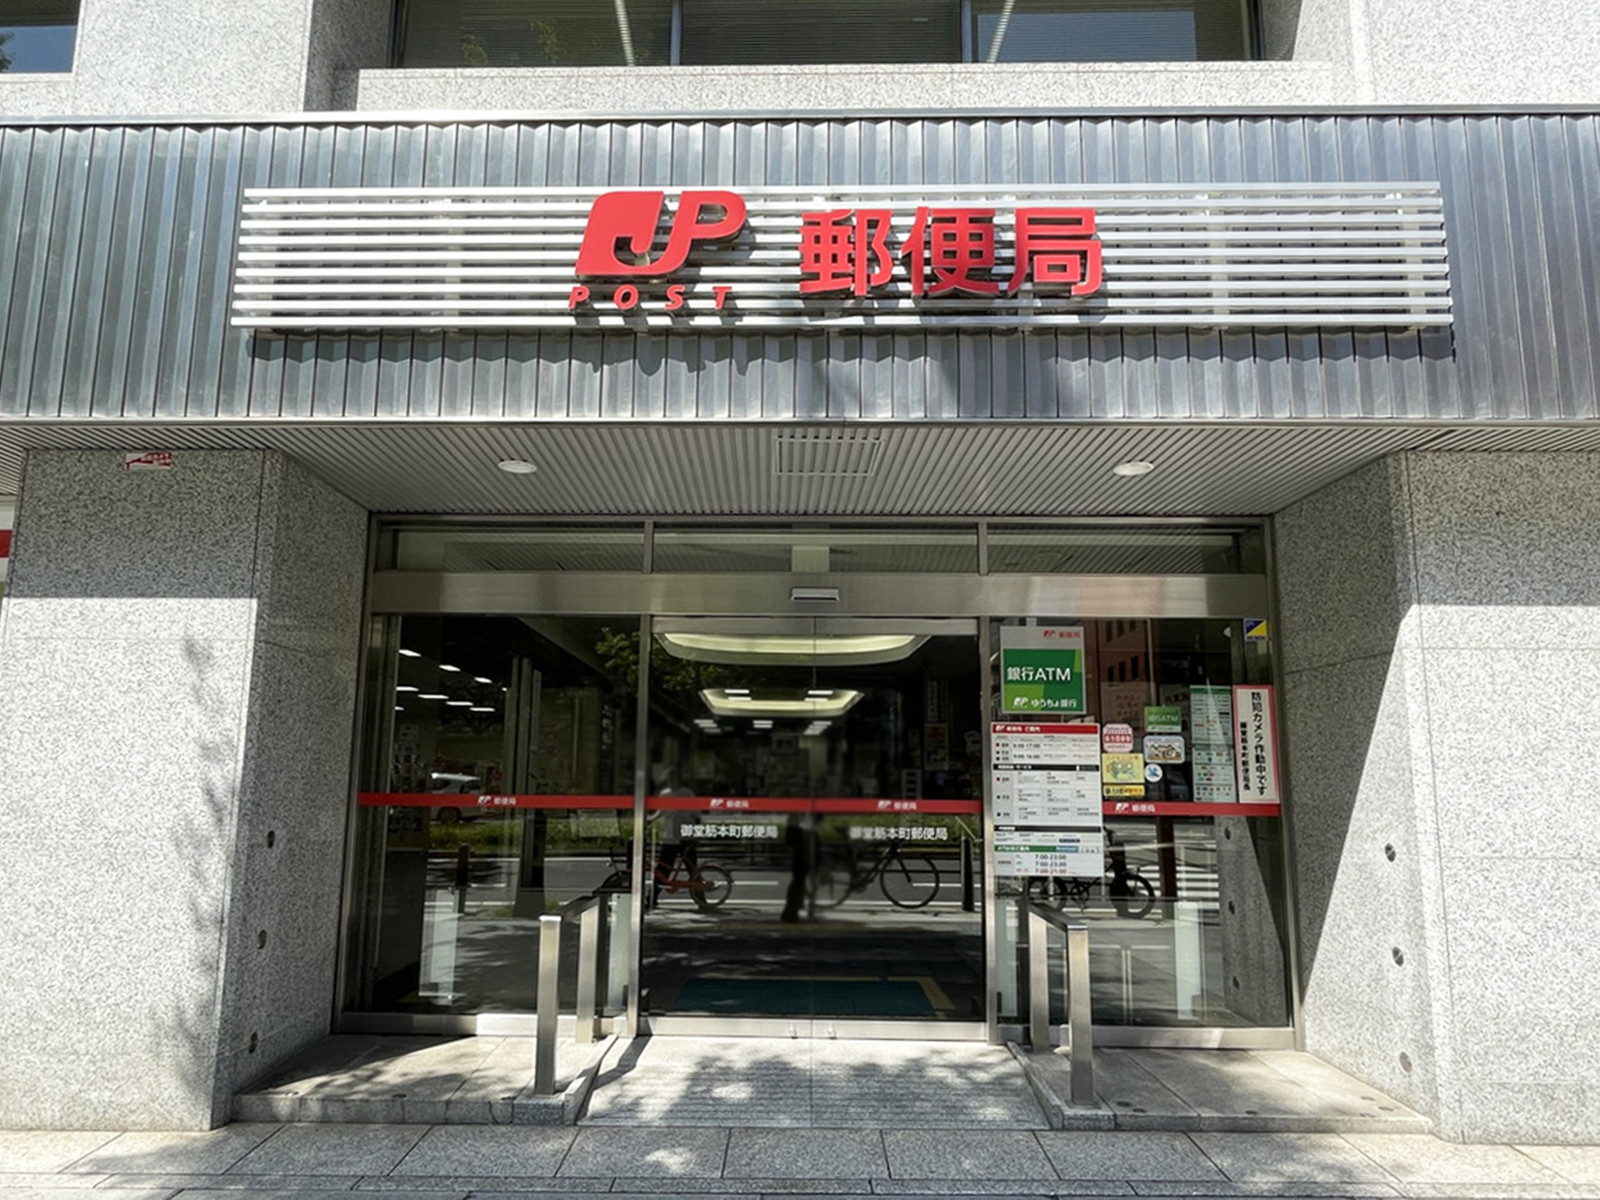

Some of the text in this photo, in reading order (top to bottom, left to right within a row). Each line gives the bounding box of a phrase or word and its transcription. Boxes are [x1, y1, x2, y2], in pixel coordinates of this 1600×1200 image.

[799, 206, 1102, 298] 郵便局
[568, 284, 733, 310] POST
[1007, 666, 1071, 681] 銀行ATM
[1031, 698, 1077, 708] ゆうちょ銀行
[1251, 691, 1267, 796] 防犯カメラ作動中です
[680, 824, 778, 840] 御堂筋本町郵便局
[850, 826, 948, 842] 御堂筋本町郵便局
